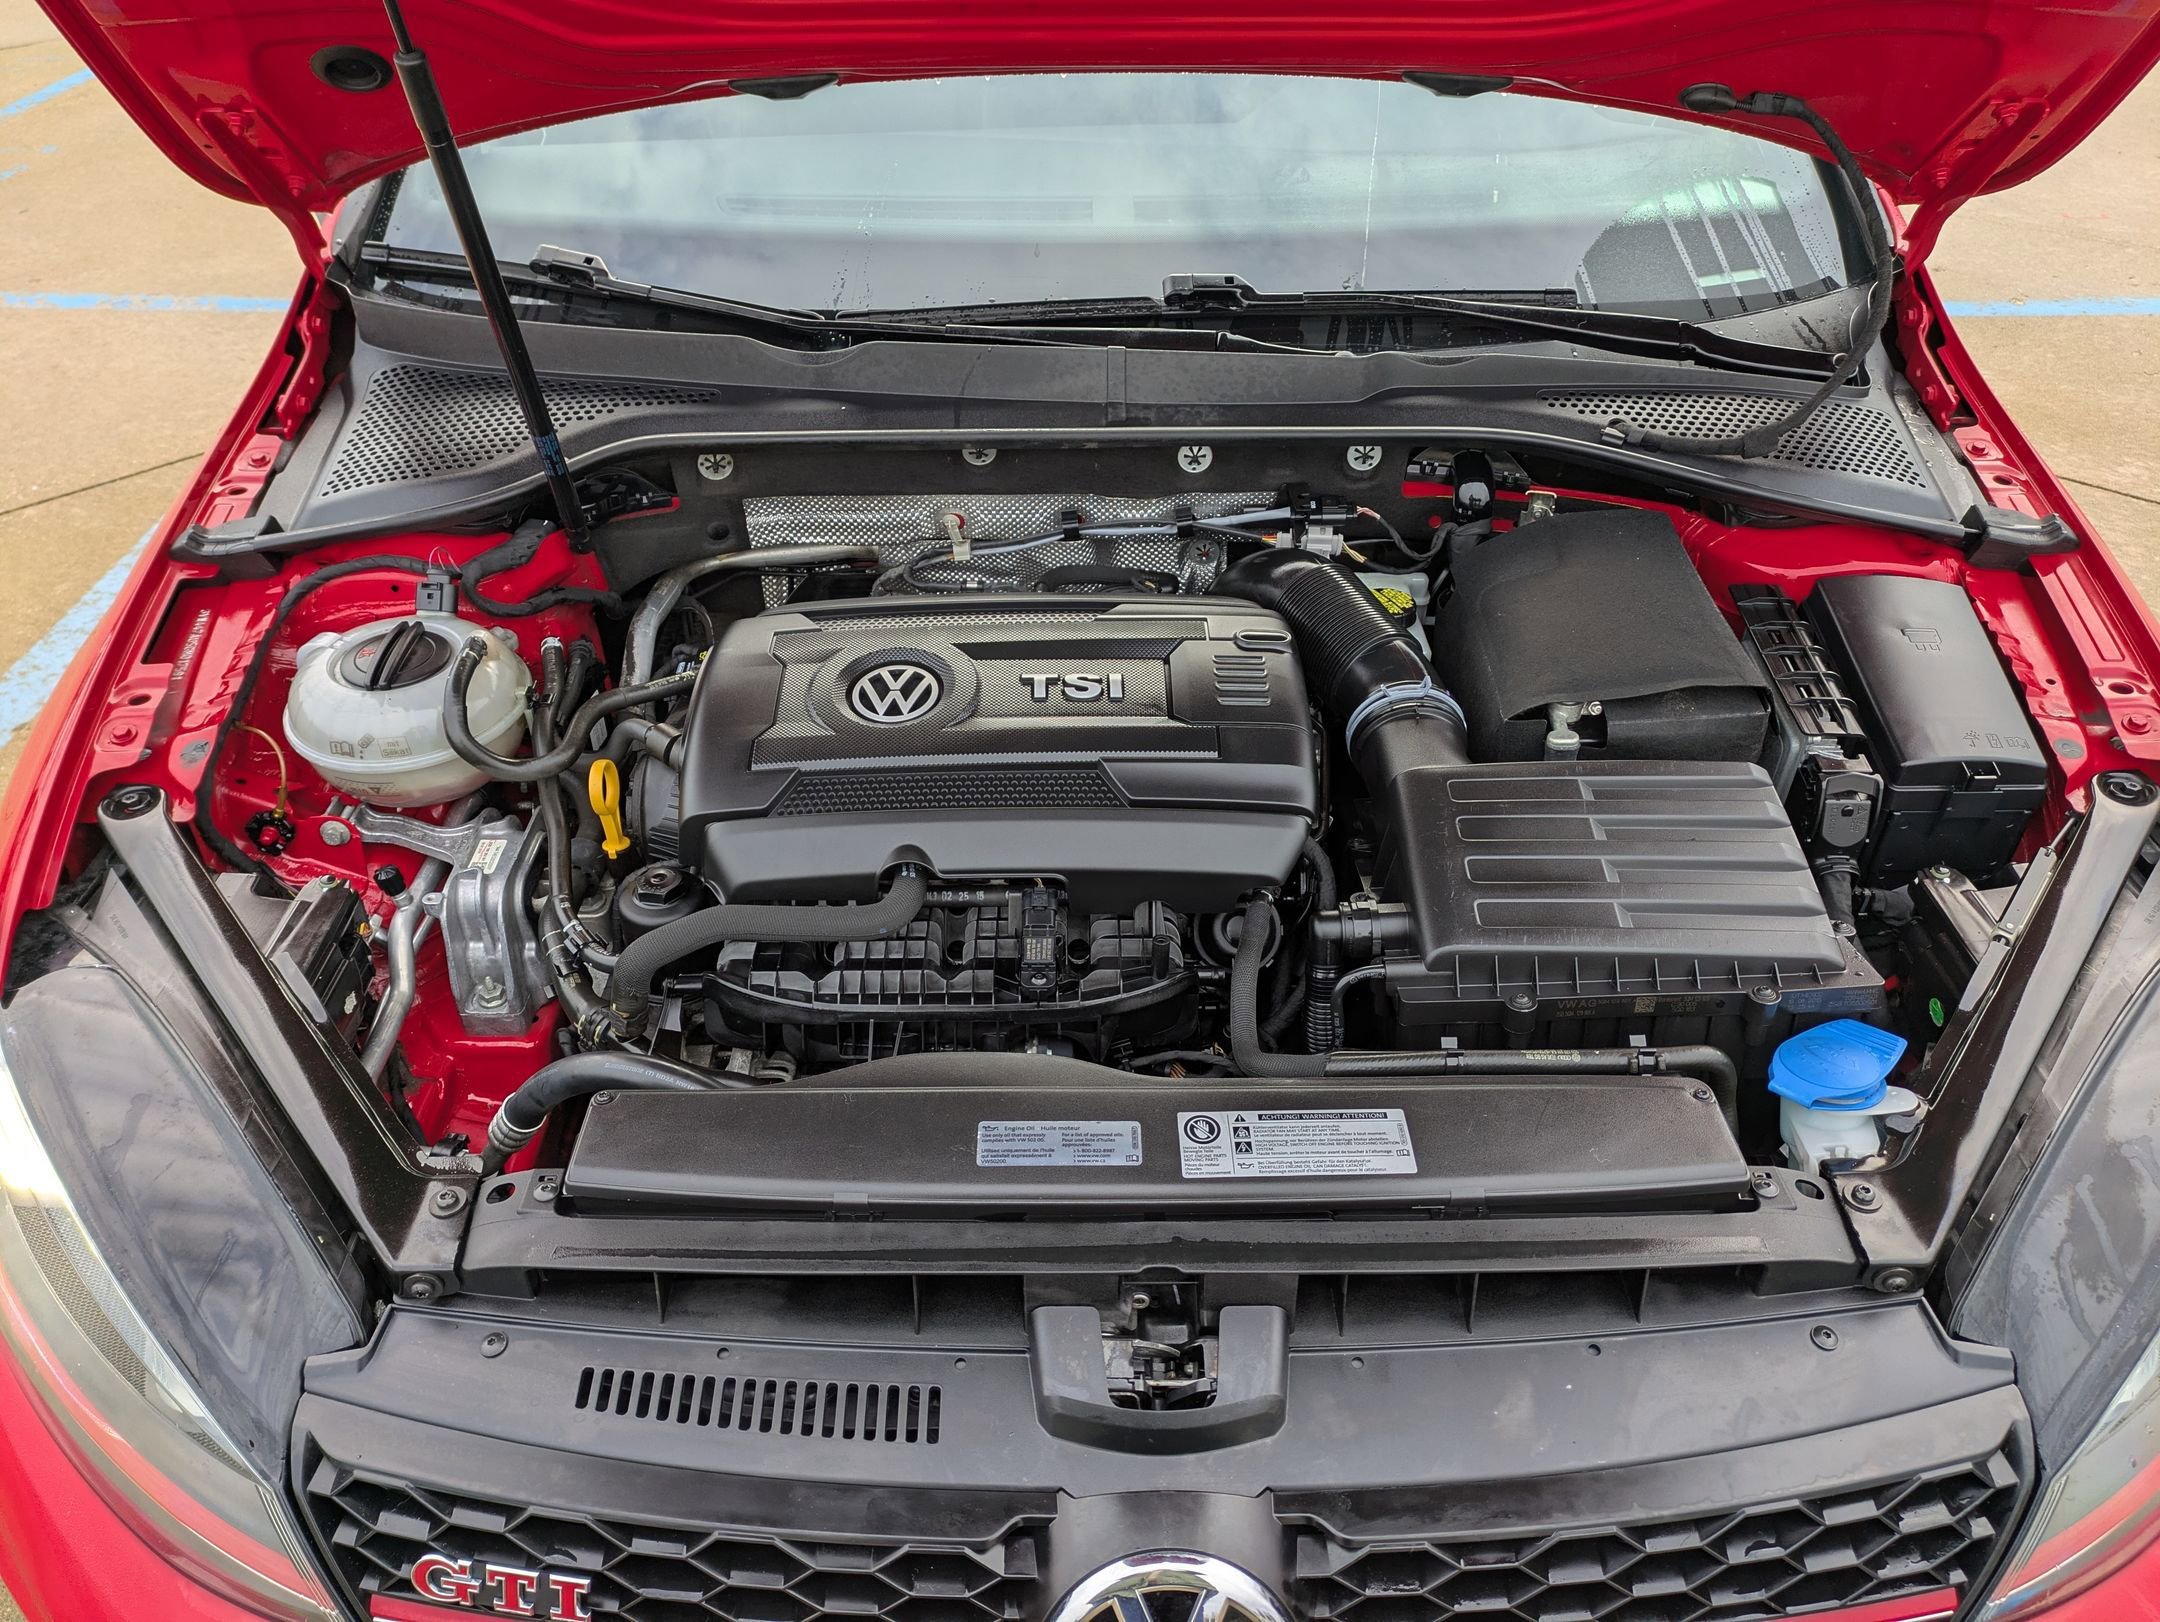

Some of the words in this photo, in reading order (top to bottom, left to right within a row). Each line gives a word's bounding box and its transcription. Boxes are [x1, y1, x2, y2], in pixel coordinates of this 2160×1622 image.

[1022, 674, 1123, 699] TSI
[958, 892, 969, 900] 25
[976, 891, 984, 900] 15
[1558, 1001, 1576, 1009] VW
[1578, 1000, 1598, 1008] AG
[411, 1554, 592, 1622] GTI
